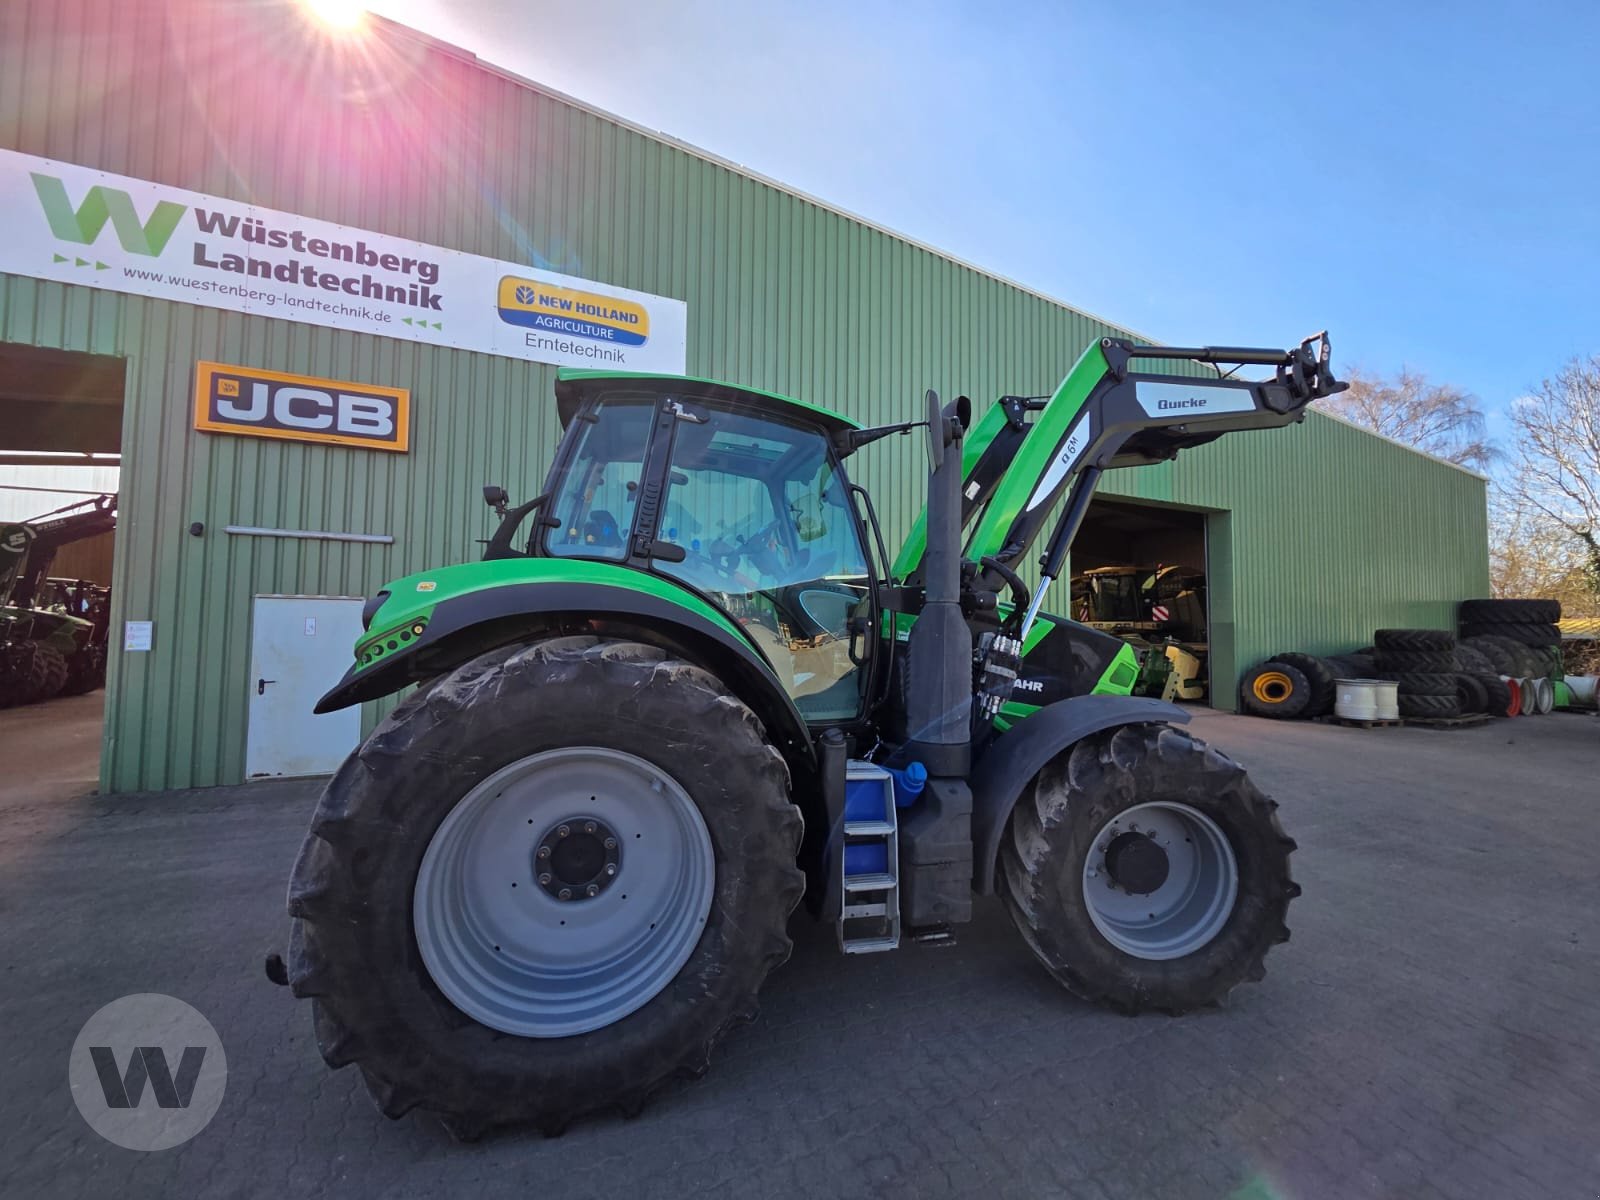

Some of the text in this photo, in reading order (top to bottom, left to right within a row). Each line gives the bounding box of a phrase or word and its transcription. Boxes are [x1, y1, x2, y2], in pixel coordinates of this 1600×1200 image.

[194, 207, 440, 285] Wüstenberg
[193, 242, 443, 311] Landtechnik
[123, 266, 392, 323] www.wuestenberg-landtechnik.de
[538, 294, 639, 324] NEW HOLLAND
[535, 315, 614, 339] AGRICULTURE
[525, 332, 625, 363] Erntetechnik
[216, 382, 393, 436] JCB
[1158, 397, 1207, 410] Quicke
[1013, 678, 1043, 692] AHR
